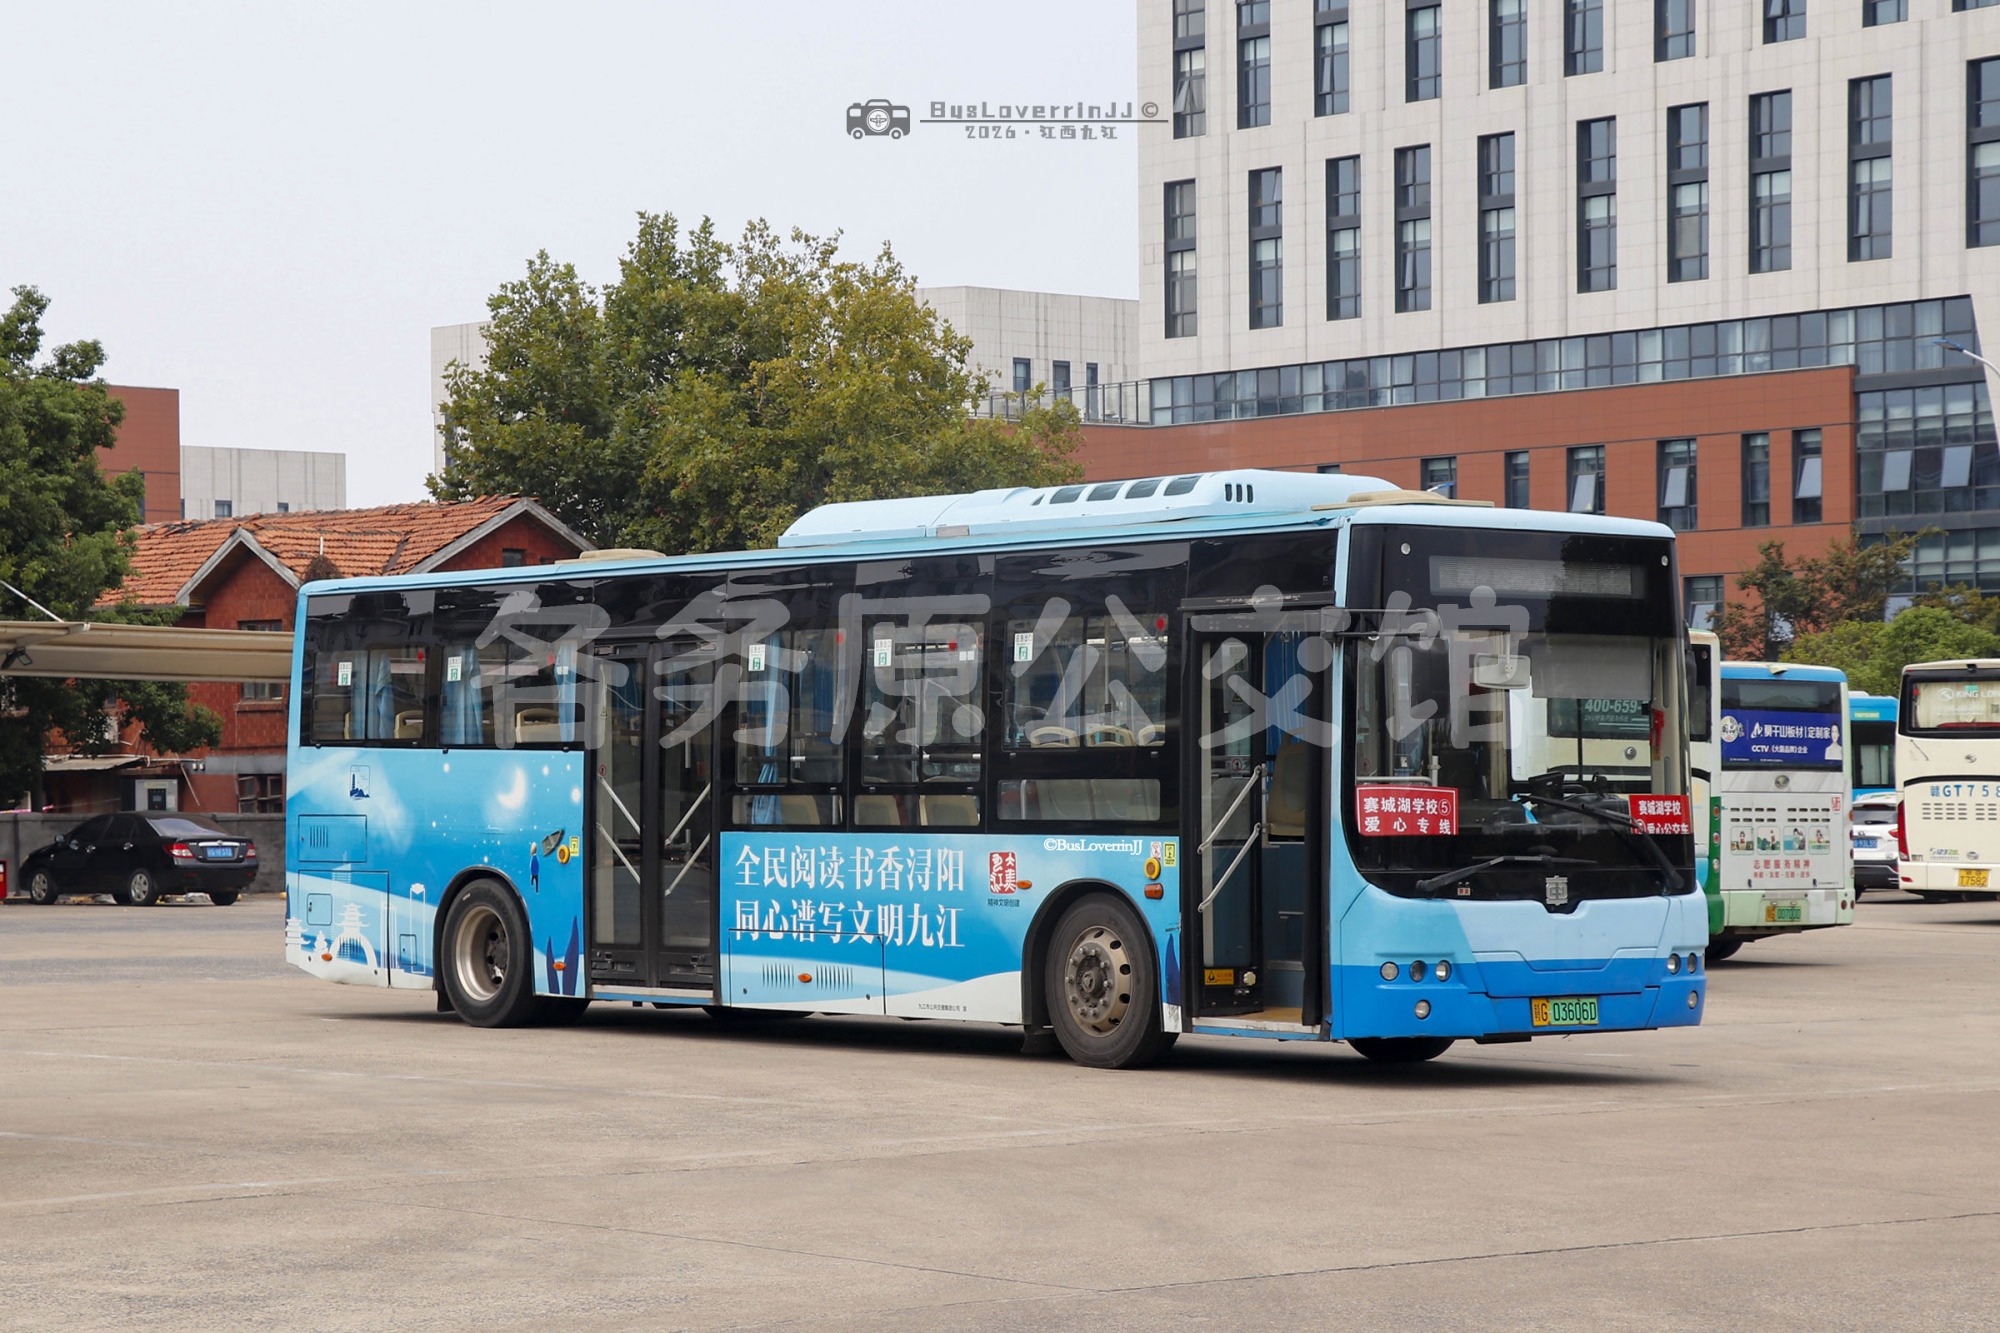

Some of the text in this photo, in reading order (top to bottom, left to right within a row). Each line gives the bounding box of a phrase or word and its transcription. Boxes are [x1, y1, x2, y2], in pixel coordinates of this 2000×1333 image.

[1638, 800, 1682, 816] 赛城湖学校
[1364, 815, 1452, 835] 爱心专线
[735, 844, 965, 891] 全民阅读书香浔阳
[734, 899, 966, 949] 同心谱写文明九江
